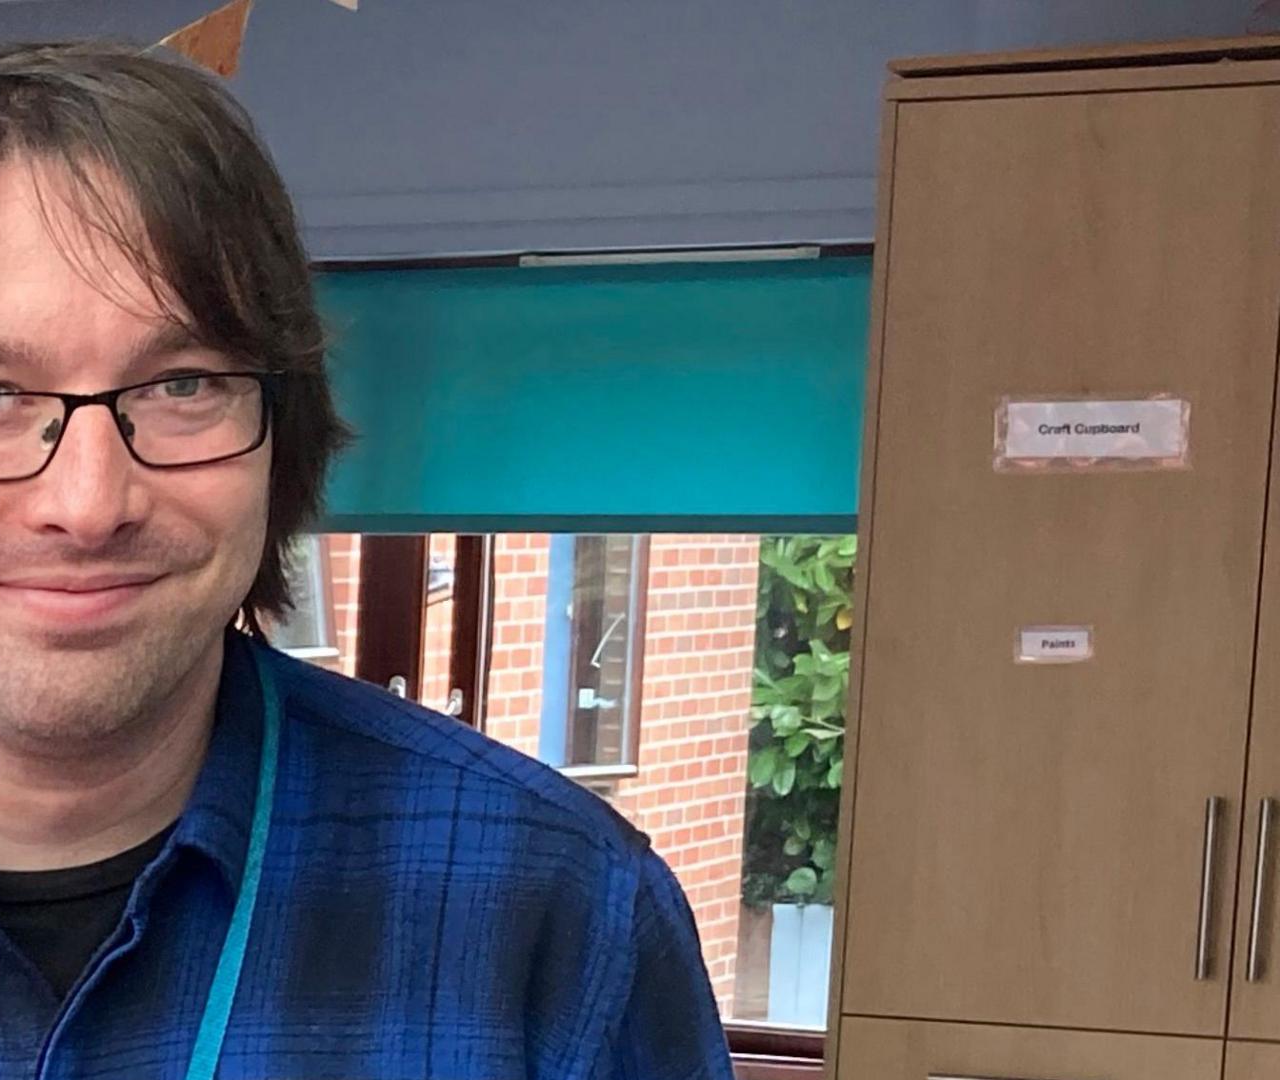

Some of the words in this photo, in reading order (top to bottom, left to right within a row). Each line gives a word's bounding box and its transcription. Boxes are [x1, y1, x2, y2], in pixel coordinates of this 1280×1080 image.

[1038, 423, 1071, 435] Craft
[1074, 422, 1140, 436] Cupboard
[1041, 638, 1076, 649] Paints
